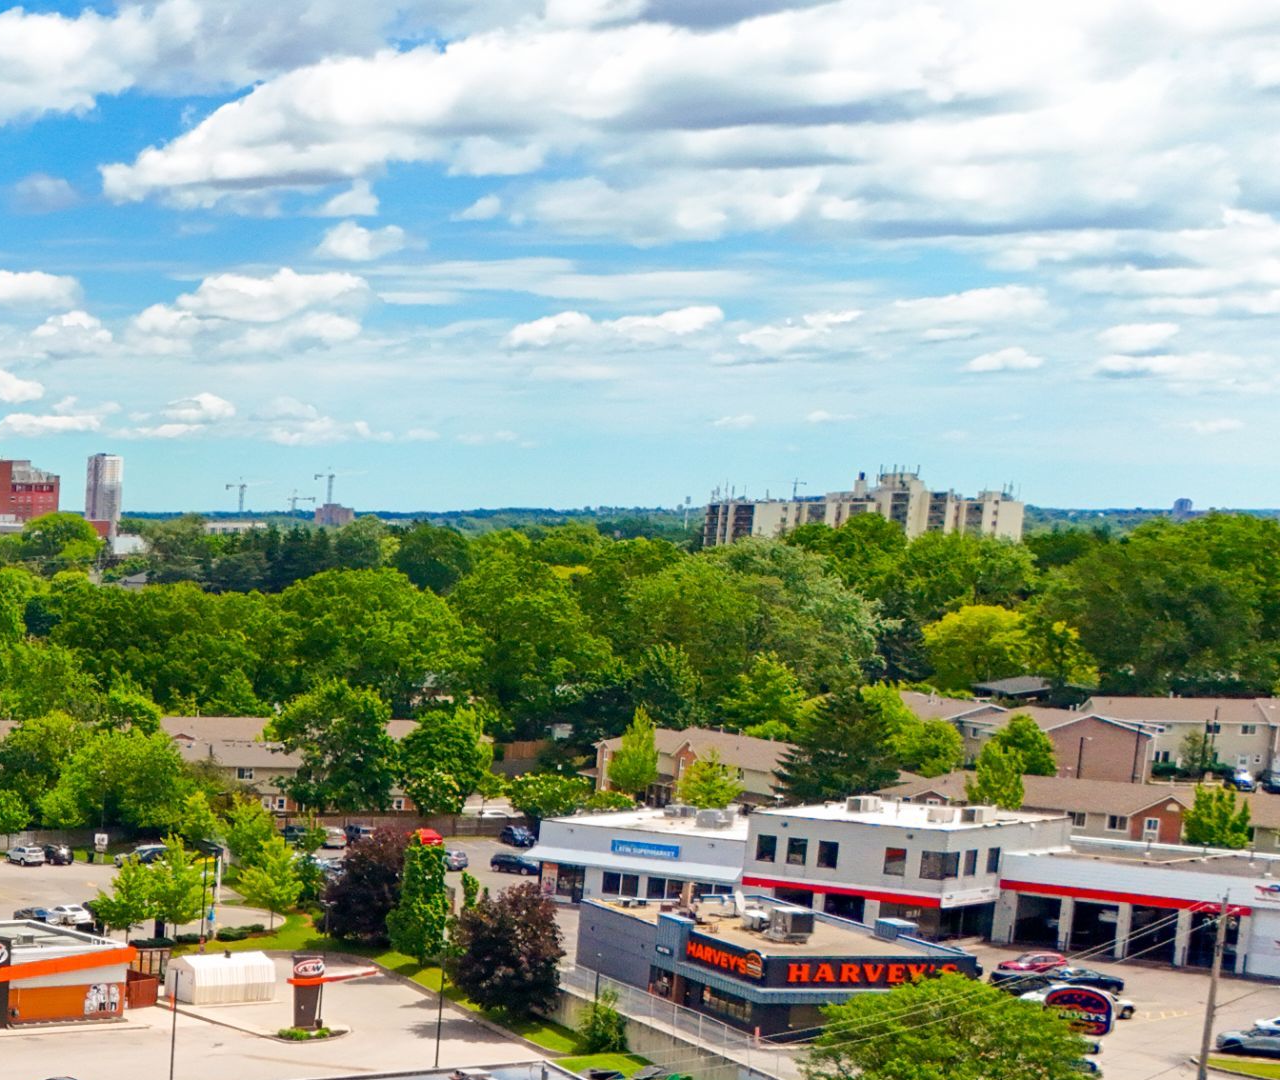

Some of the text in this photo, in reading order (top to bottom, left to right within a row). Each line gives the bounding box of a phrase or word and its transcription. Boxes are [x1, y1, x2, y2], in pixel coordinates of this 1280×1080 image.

[633, 847, 675, 858] SUPERMARKET
[687, 941, 747, 975] HARVEY'S
[298, 963, 323, 972] A&W
